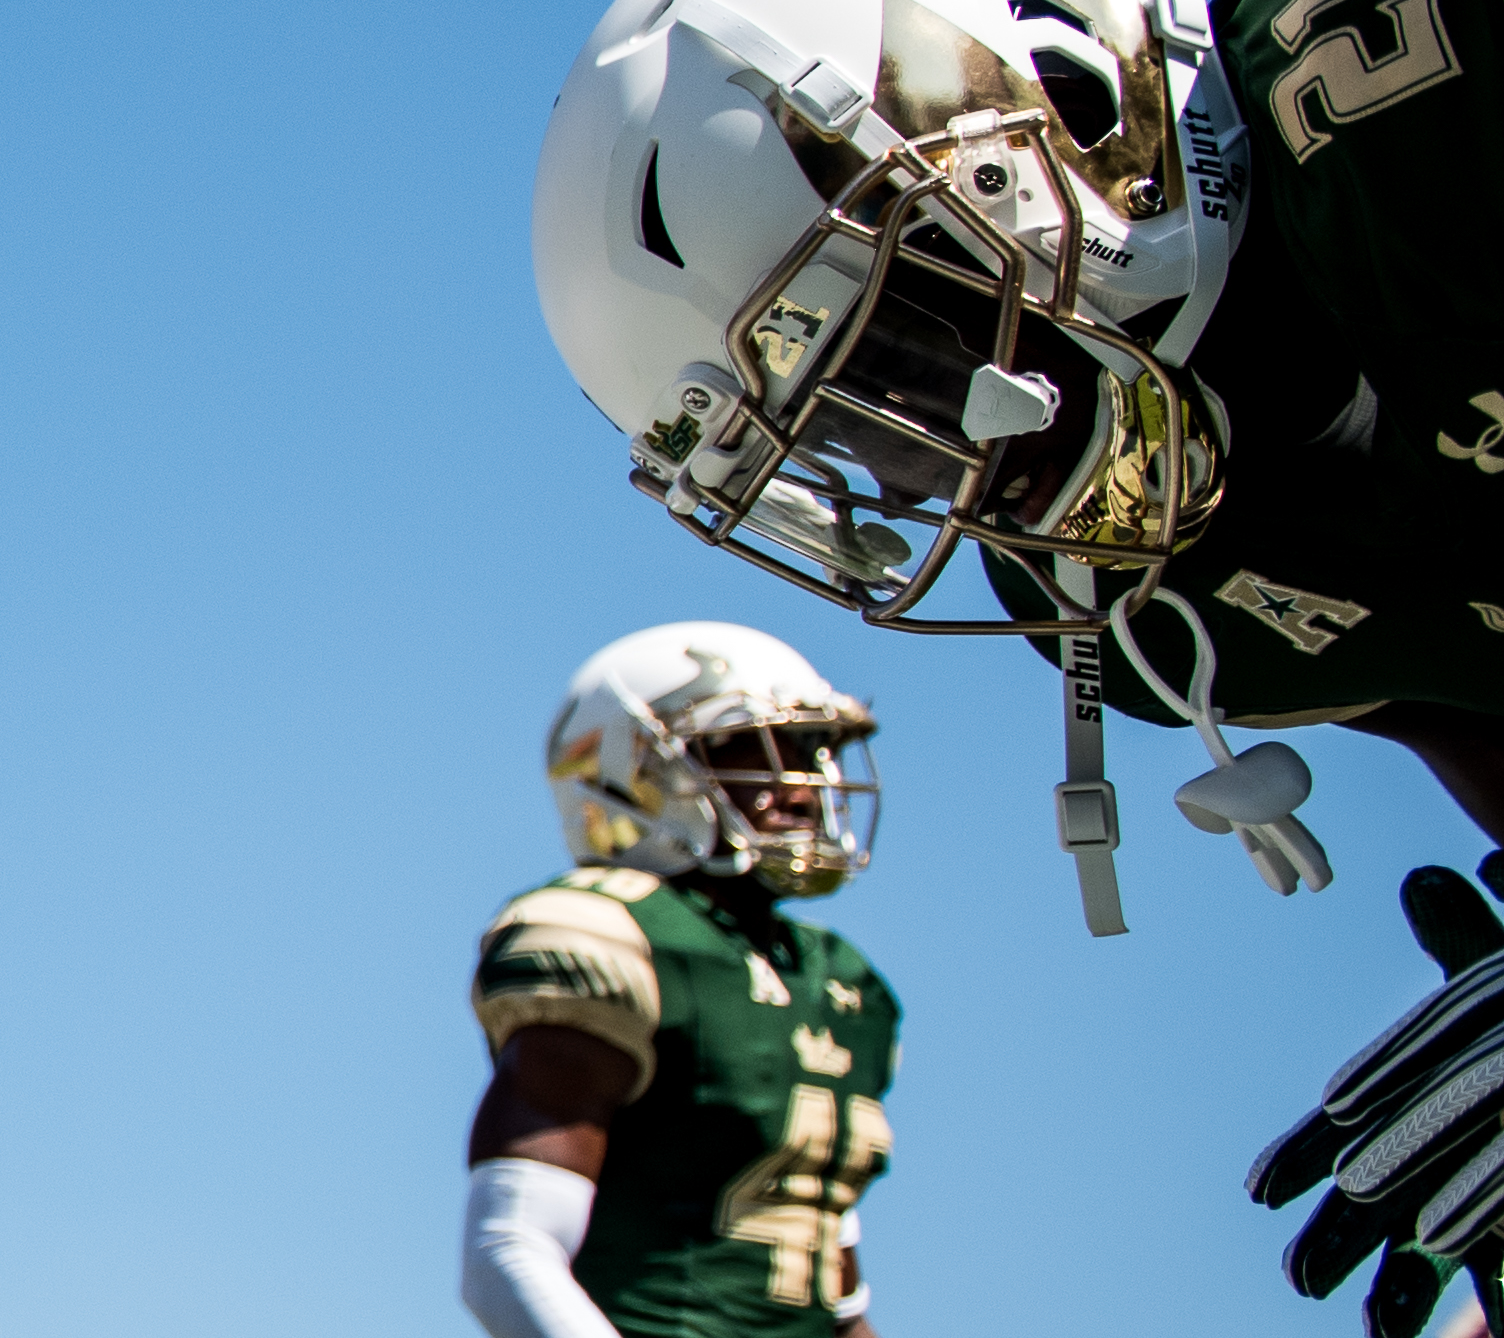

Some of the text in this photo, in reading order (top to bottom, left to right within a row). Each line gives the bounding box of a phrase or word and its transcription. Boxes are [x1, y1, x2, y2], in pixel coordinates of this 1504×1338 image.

[1181, 107, 1229, 223] schutt
[1080, 237, 1135, 269] chutt
[1065, 638, 1102, 724] schu
